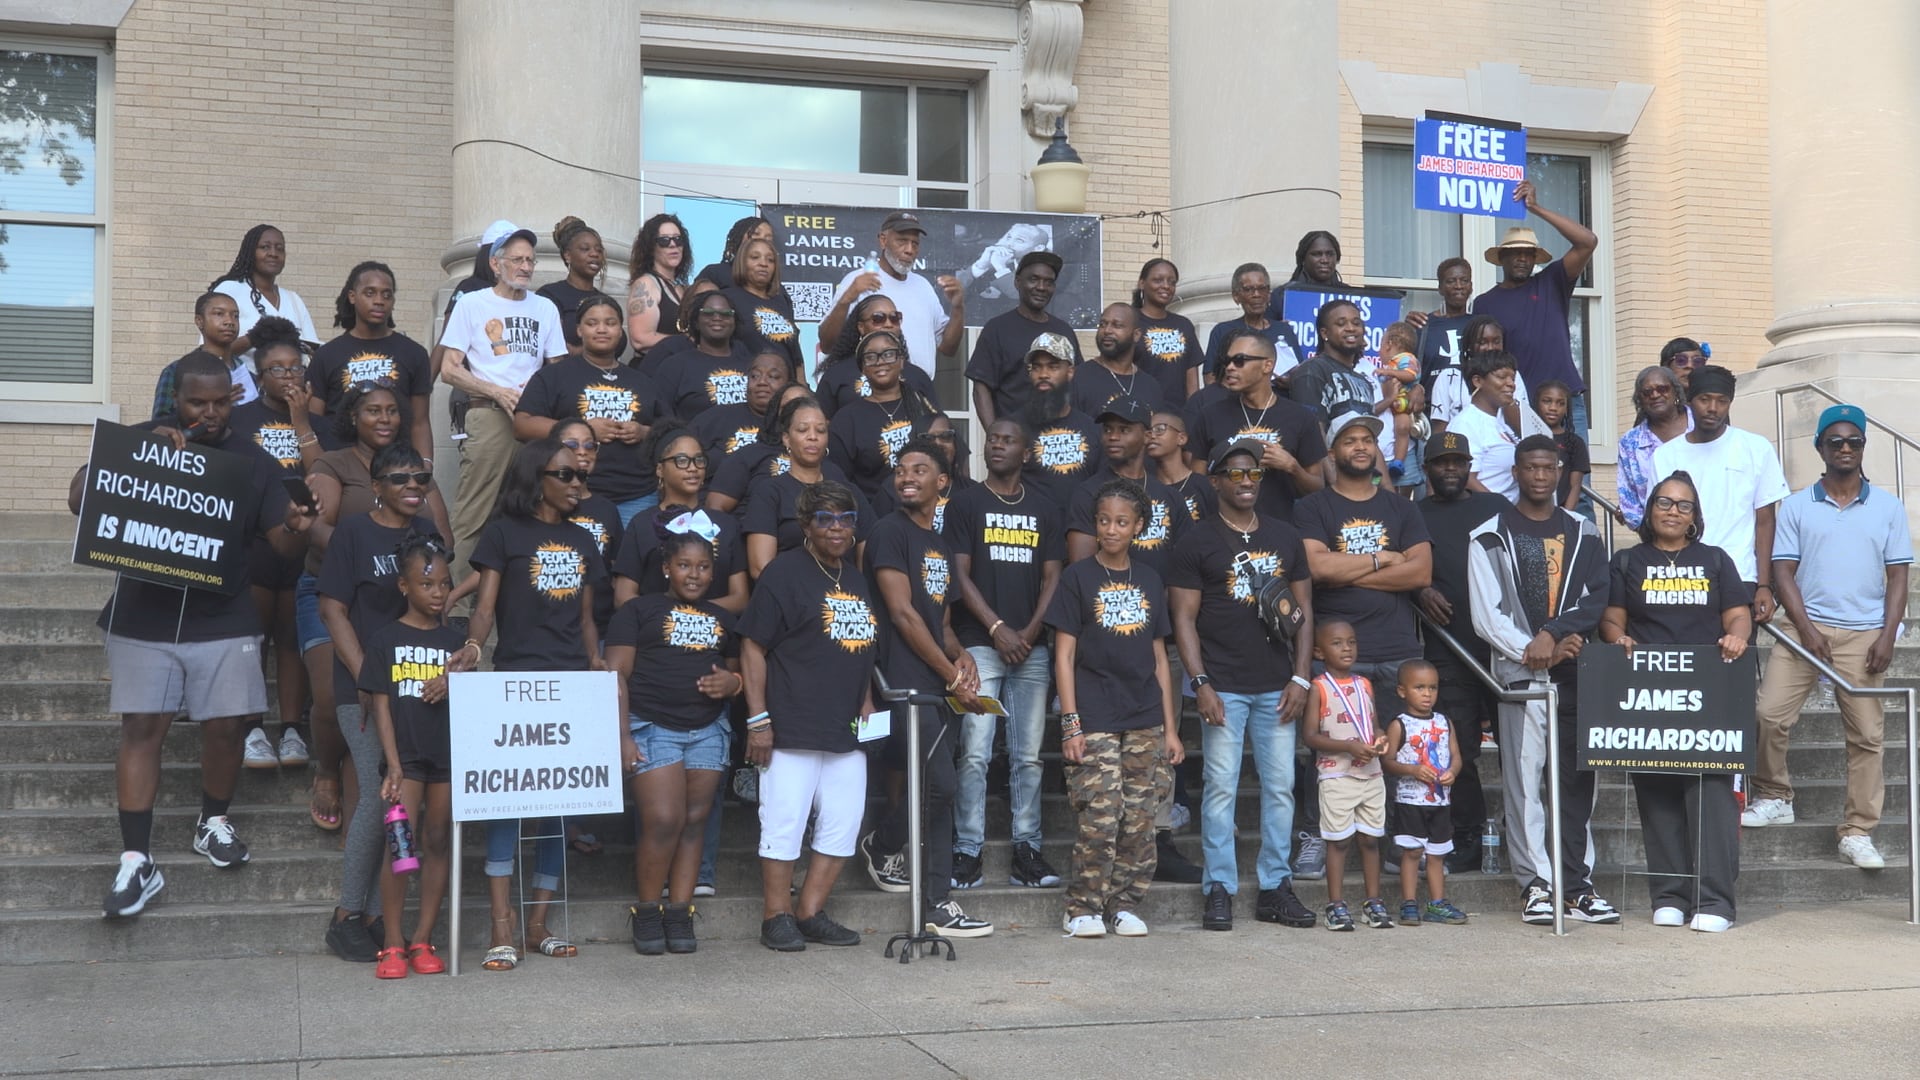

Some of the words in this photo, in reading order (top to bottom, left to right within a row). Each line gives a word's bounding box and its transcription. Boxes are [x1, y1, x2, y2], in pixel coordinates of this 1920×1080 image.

[1438, 125, 1506, 161] FREE
[1417, 155, 1455, 174] JAMES
[1455, 159, 1524, 181] RICHARDSON
[1439, 176, 1505, 212] NOW
[784, 215, 836, 230] FREE
[784, 234, 856, 249] JAMES
[785, 253, 927, 270] RICHARN
[507, 329, 539, 348] JAMS
[1151, 343, 1185, 355] RACISM
[347, 359, 393, 374] PEOPLE
[708, 375, 748, 386] PEOPL
[717, 384, 748, 392] AGAINS
[583, 389, 633, 401] PEOPLE
[715, 392, 748, 405] RACIS
[588, 401, 633, 411] AGAINST
[259, 428, 298, 438] PEOPL
[880, 424, 913, 444] PEOP
[1038, 433, 1081, 446] PEOPLE
[262, 437, 299, 447] AGAINS
[1043, 443, 1080, 453] AGAINST
[132, 440, 207, 476] JAMES
[1041, 451, 1084, 467] RACISM
[96, 469, 234, 521] RICHARDSON
[985, 512, 1037, 531] PEOPLE
[97, 513, 119, 539] IS
[122, 519, 225, 562] INNOCENT
[983, 528, 1040, 548] AGAINST
[1340, 524, 1383, 541] PEOPLE
[535, 550, 581, 564] PEOPLE
[989, 546, 1033, 564] RACISM
[89, 550, 223, 585] WWW.FREEJAMESRICHARDSON.ORG
[541, 563, 580, 575] AGAINST
[1232, 556, 1278, 575] PPLE
[1646, 566, 1705, 580] PEOPLE
[537, 574, 582, 591] RACISM
[1641, 578, 1711, 592] AGAINST
[1098, 589, 1142, 603] PEOPLE
[1645, 591, 1708, 605] RACISM
[824, 597, 870, 613] PEOPLE
[1105, 600, 1142, 613] AGAINST
[670, 610, 716, 624] PEOPLE
[833, 612, 870, 623] AGAINST
[1101, 608, 1146, 628] RACISM
[674, 621, 716, 634] AGAINST
[830, 622, 875, 641] RACISM
[670, 632, 719, 648] RACISM
[1632, 651, 1694, 673] FREE
[391, 661, 445, 683] AGAINS
[398, 679, 425, 698] RAC
[504, 680, 562, 702] FREE
[1619, 688, 1703, 712] JAMES
[494, 722, 571, 747] JAMES
[1588, 726, 1743, 753] RICHARDSON
[1587, 759, 1745, 770] WWW.FREEJAMESRICHARDSON.ORG
[464, 765, 610, 794] RICHARDSON
